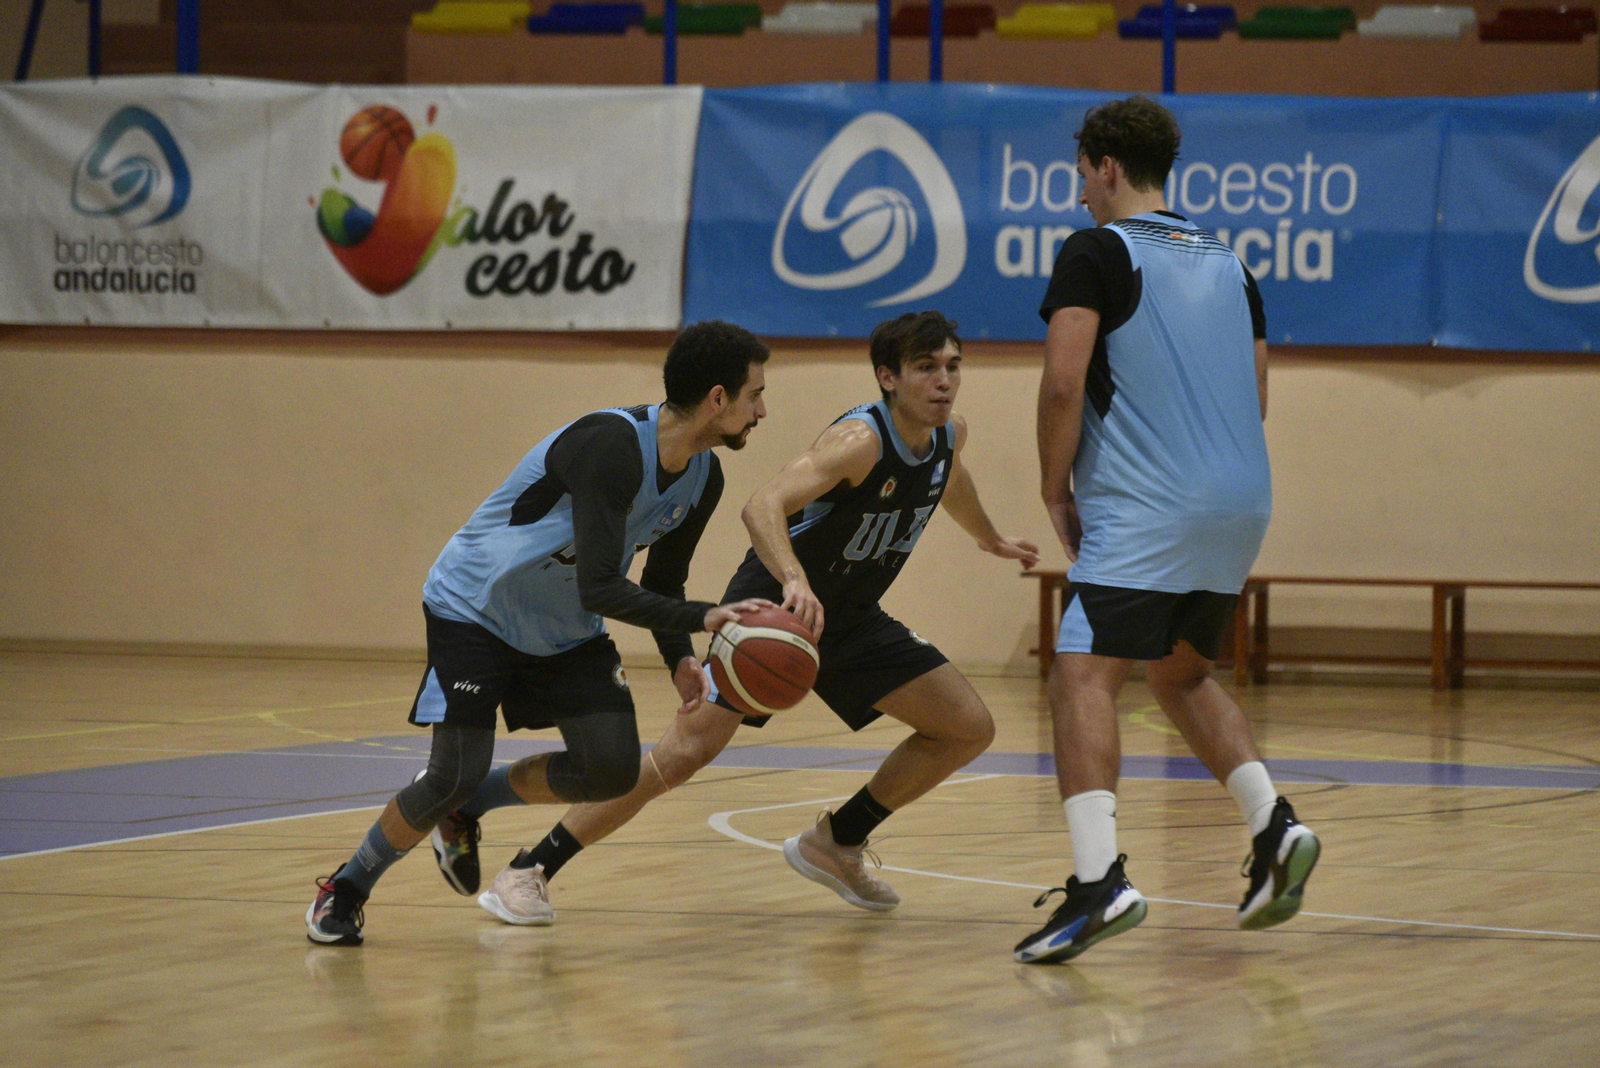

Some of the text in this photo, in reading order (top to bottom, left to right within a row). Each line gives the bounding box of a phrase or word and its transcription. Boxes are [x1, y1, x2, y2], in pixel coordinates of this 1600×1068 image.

[1001, 143, 1357, 215] bacesto
[54, 232, 203, 266] baloncesto
[466, 233, 635, 296] cesto
[995, 217, 1334, 282] ancía
[453, 679, 481, 695] vive
